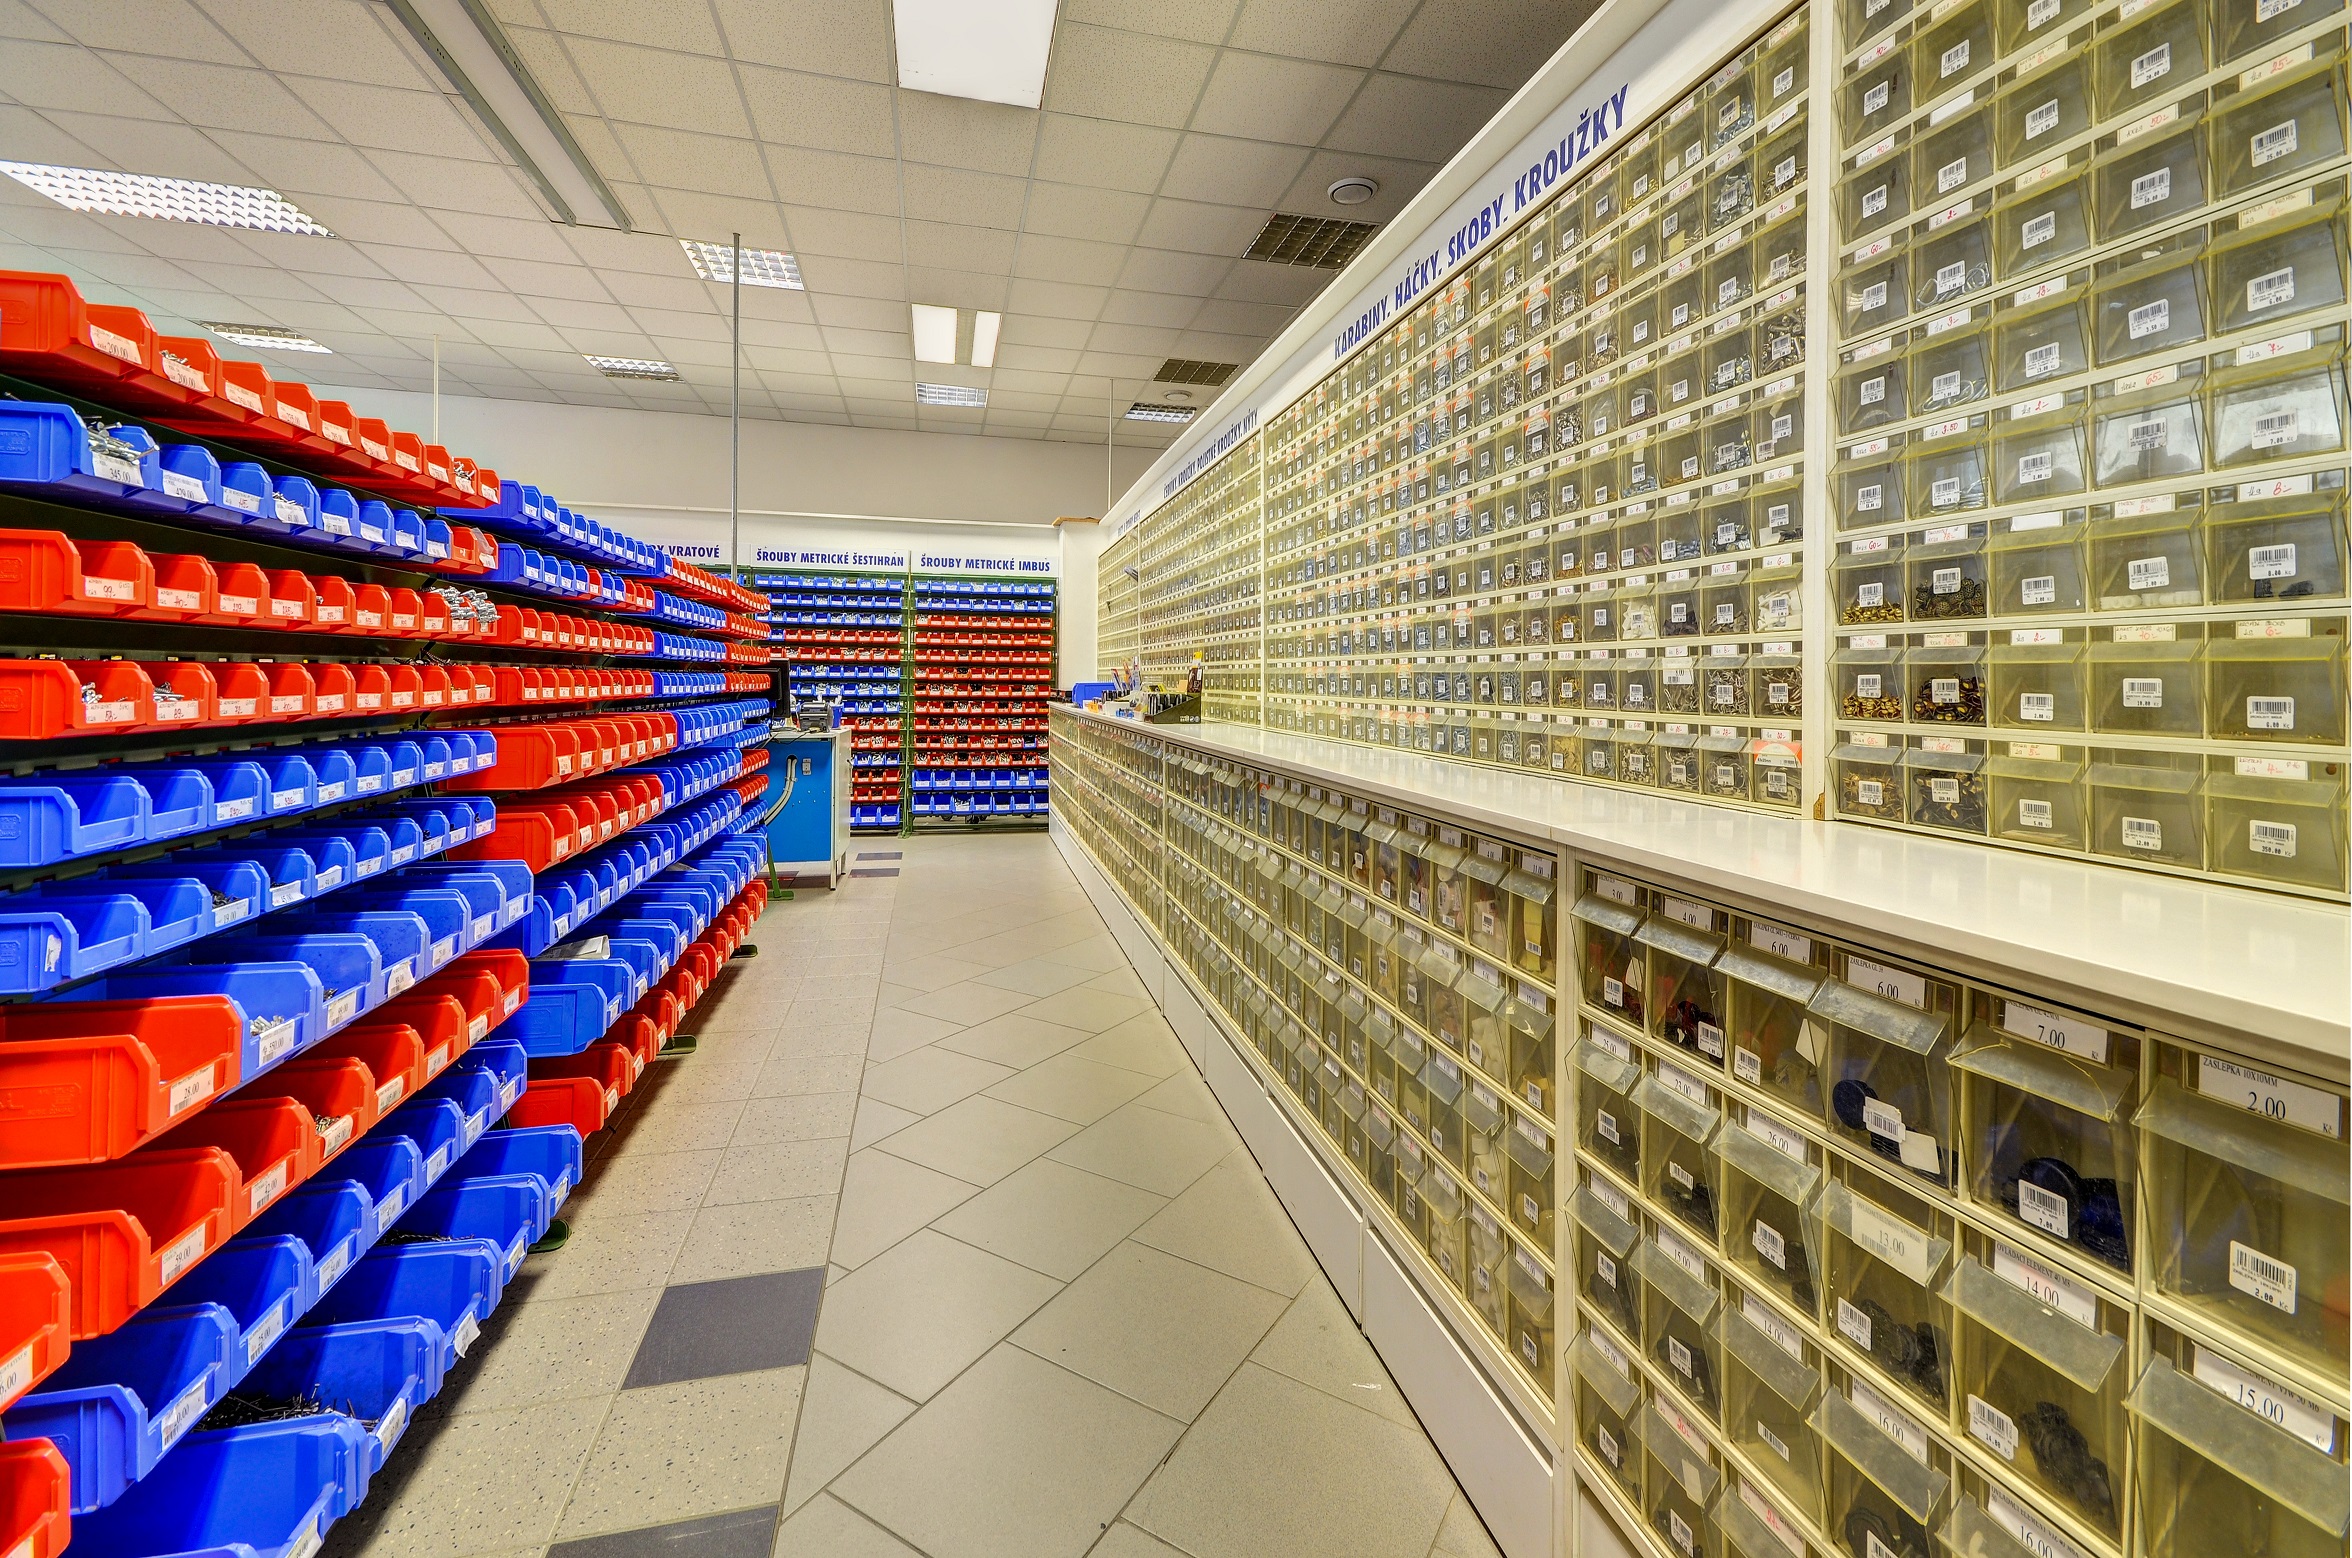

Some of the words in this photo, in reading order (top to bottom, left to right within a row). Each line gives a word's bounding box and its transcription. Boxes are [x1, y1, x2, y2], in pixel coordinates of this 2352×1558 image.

[2270, 2, 2289, 16] 150.00
[1514, 82, 1630, 214] KROUŽKY
[2266, 149, 2283, 161] 25.00
[2270, 437, 2284, 445] 7.00
[109, 466, 131, 483] 345.00
[668, 544, 720, 559] VRATOVÉ
[756, 547, 797, 563] ŠROUBY
[800, 551, 849, 565] METRICKÉ
[852, 552, 904, 567] ŠESTIHRAN
[920, 553, 961, 568] ŠROUBY
[965, 557, 1015, 571] METRICKÉ
[1018, 560, 1050, 572] IMBUS
[1771, 941, 1789, 957] 6.00
[1877, 981, 1899, 1000] 6.00
[2037, 1024, 2065, 1049] 7.00
[2203, 1057, 2241, 1077] ZASLEPKA
[184, 1081, 200, 1101] 28.00
[2247, 1091, 2286, 1121] 2.00
[1768, 1131, 1789, 1152] 26.00
[2039, 1217, 2053, 1230] 7.00
[1879, 1229, 1905, 1257] 13.00
[175, 1245, 191, 1267] 59.00
[1997, 1243, 2025, 1264] OVLADACI
[2025, 1257, 2053, 1279] ELEMENT
[2026, 1276, 2060, 1308] 14.00
[2254, 1287, 2274, 1304] 2.00
[1763, 1319, 1784, 1346] 14.00
[2237, 1384, 2284, 1424] 15.00
[1879, 1412, 1904, 1443] 16.00
[1985, 1432, 2001, 1449] 14.00
[2021, 1525, 2053, 1558] 16.00
